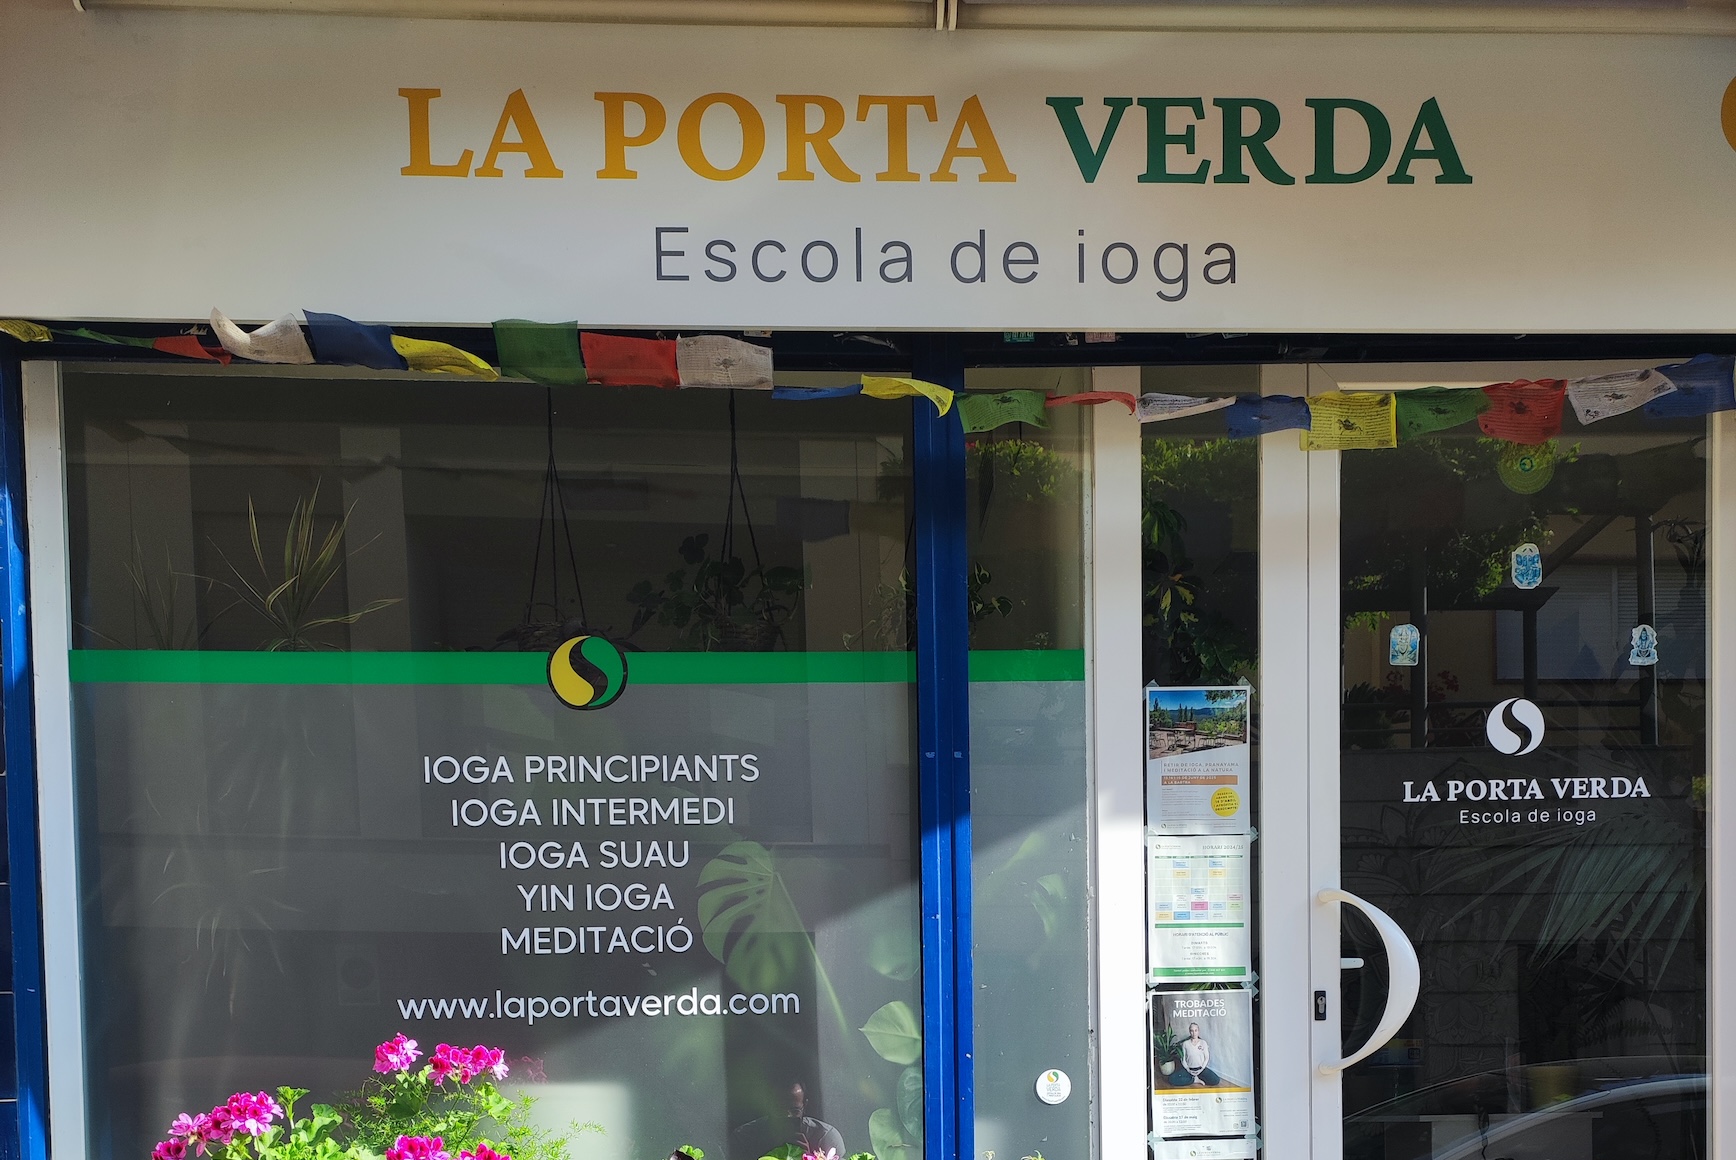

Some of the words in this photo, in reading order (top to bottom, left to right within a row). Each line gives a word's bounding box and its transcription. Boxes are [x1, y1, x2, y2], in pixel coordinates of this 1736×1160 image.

[398, 87, 564, 178] LA
[594, 90, 1017, 185] PORTA
[1046, 96, 1473, 186] VERDA
[655, 226, 914, 285] Escola
[950, 228, 1041, 285] de
[1077, 228, 1239, 302] ioga
[424, 756, 514, 783] IOGA
[525, 754, 760, 783] PRINCIPIANTS
[1403, 781, 1441, 803] LA
[1447, 778, 1544, 802] PORTA
[1551, 776, 1651, 800] VERDA
[451, 798, 542, 826] IOGA
[553, 797, 735, 826] INTERMEDI
[1459, 809, 1521, 824] Escola
[1528, 808, 1550, 823] de
[1556, 807, 1597, 825] ioga
[499, 841, 589, 870] IOGA
[599, 840, 690, 869] SUAU
[516, 883, 574, 911] YIN
[586, 882, 675, 911] IOGA
[501, 918, 693, 955] MEDITACIÓ
[397, 987, 801, 1024] www.laportaverda.com
[1173, 1007, 1227, 1018] MEDITACIÓ
[1174, 999, 1225, 1008] TROBADES
